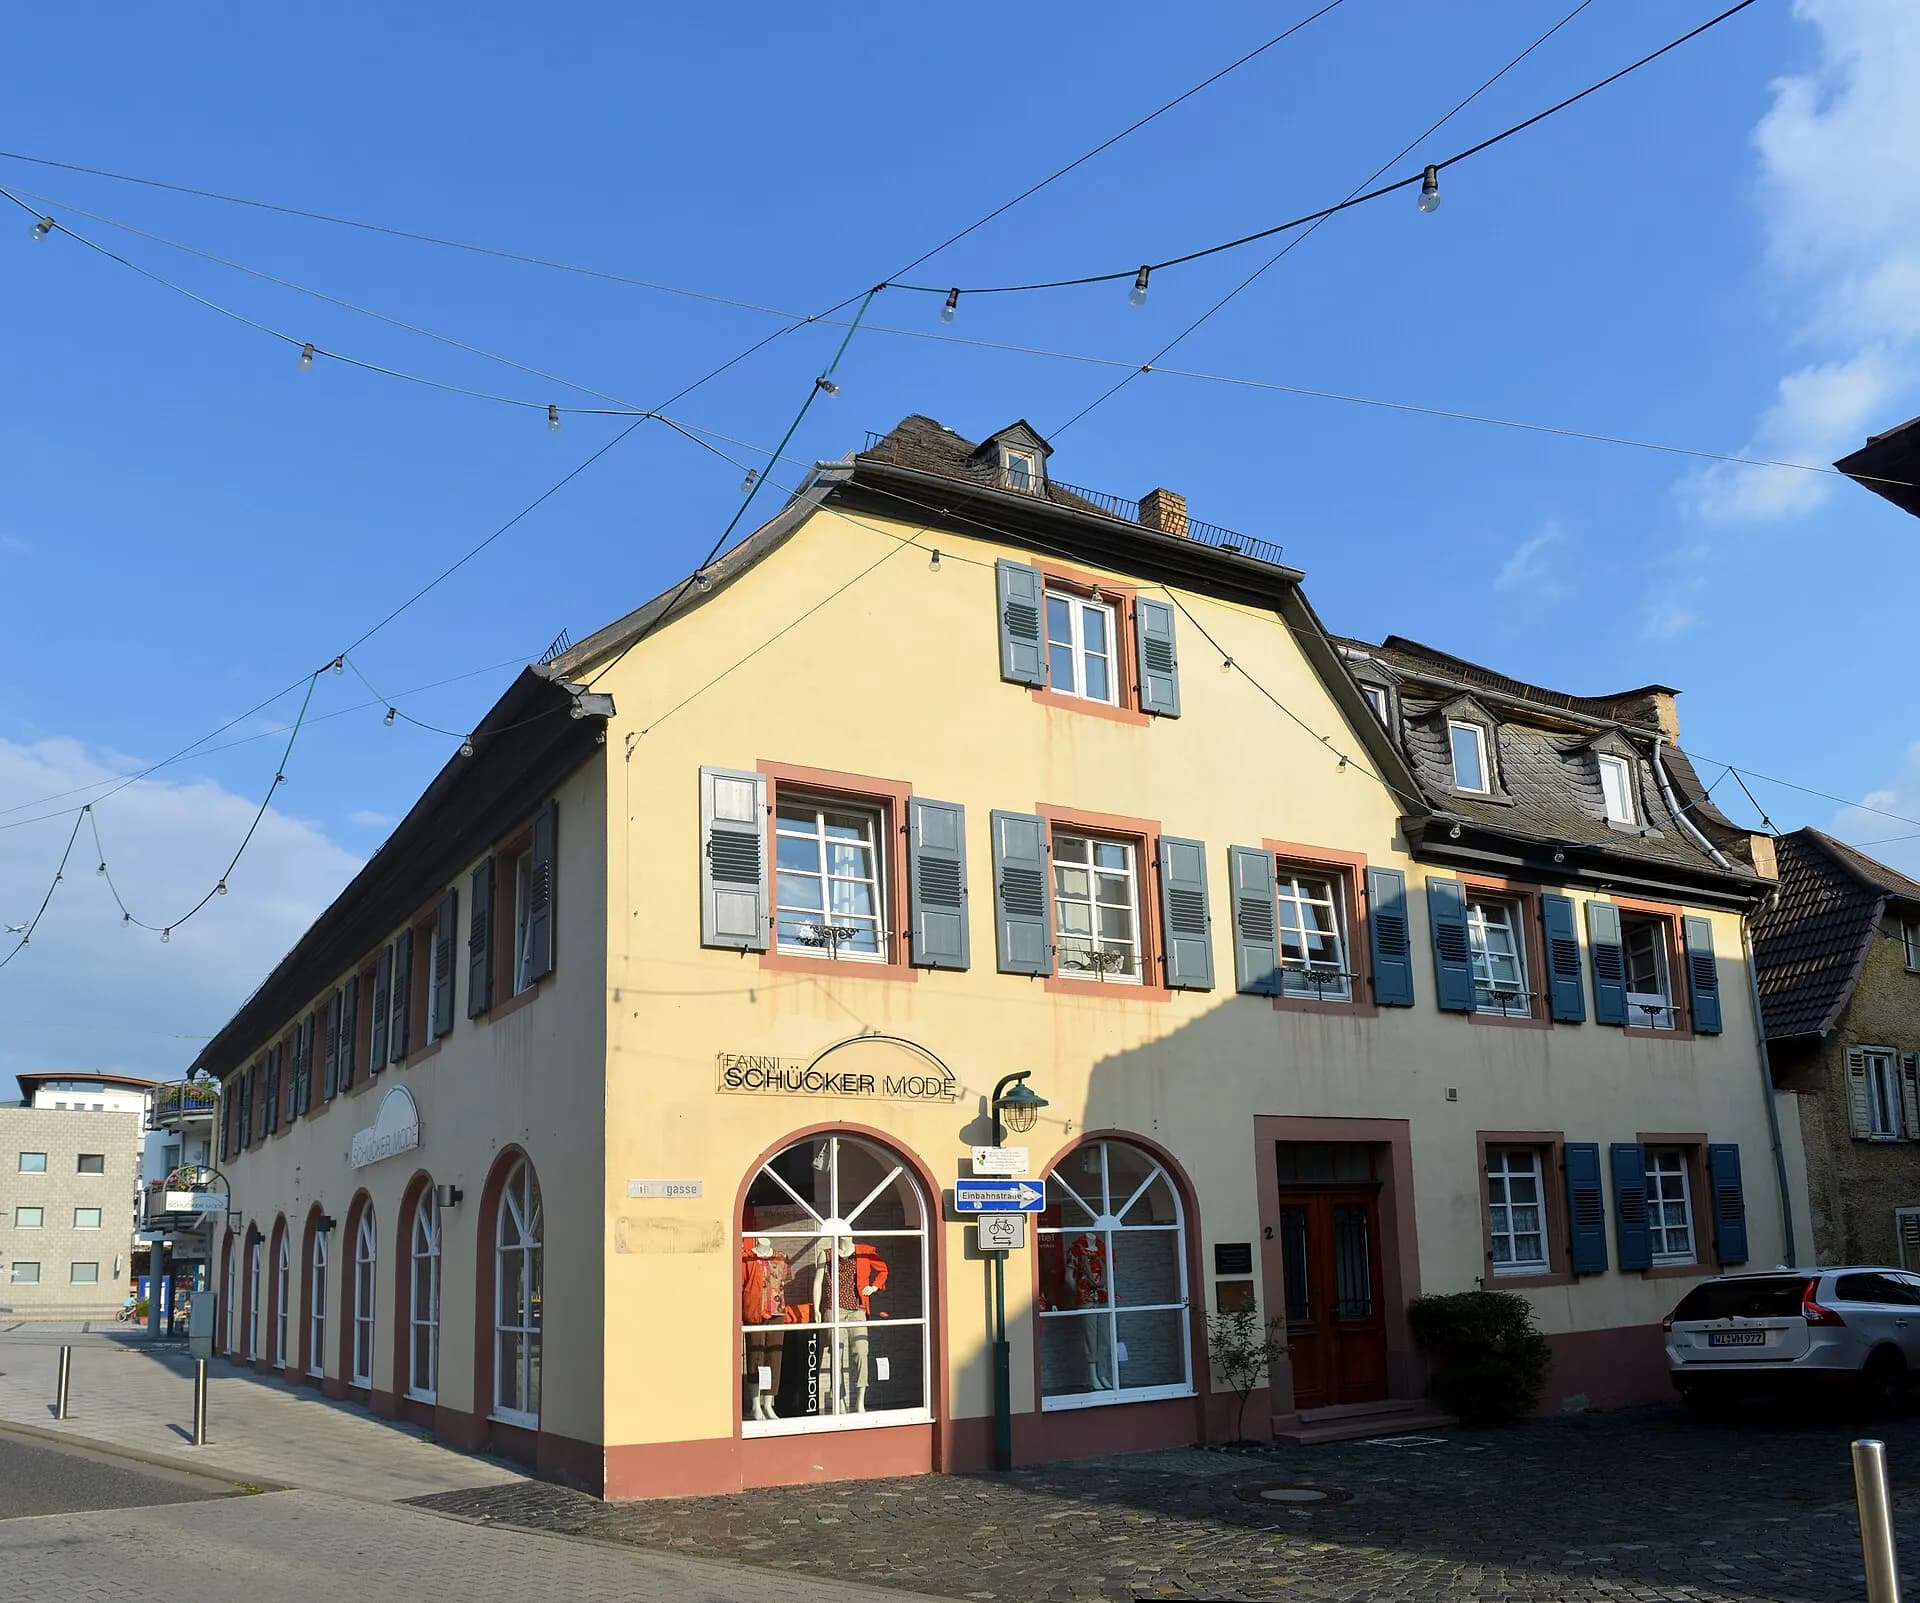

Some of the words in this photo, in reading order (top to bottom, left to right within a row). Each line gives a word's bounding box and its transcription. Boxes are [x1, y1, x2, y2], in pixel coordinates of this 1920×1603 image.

[725, 1053, 780, 1070] FANNI
[725, 1065, 875, 1093] SCHÜCKER
[886, 1075, 956, 1096] MODE
[1264, 1226, 1274, 1240] 2
